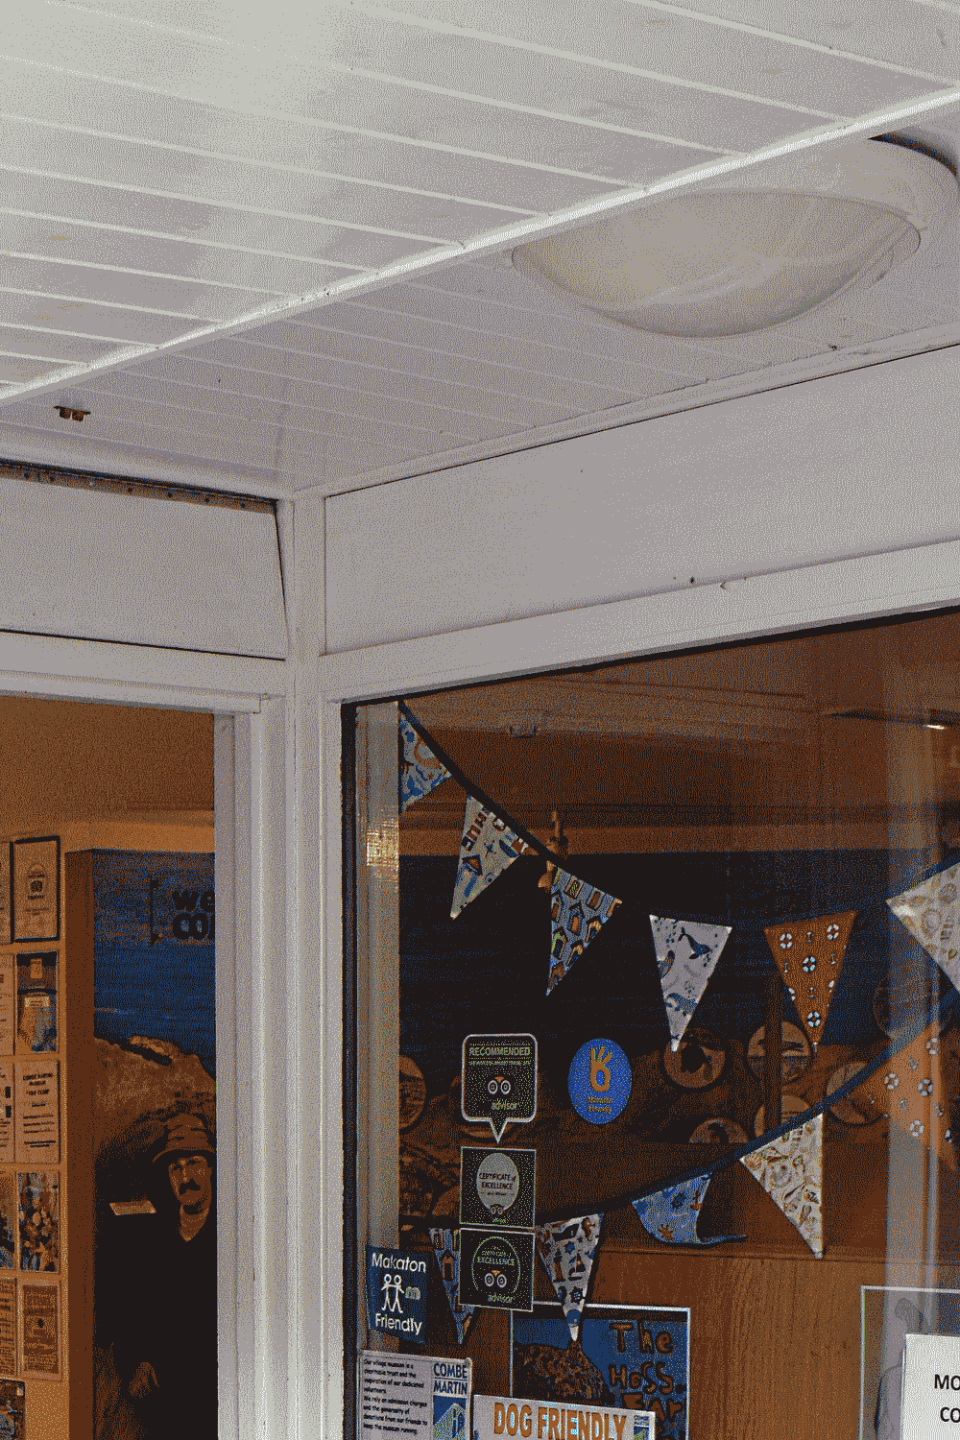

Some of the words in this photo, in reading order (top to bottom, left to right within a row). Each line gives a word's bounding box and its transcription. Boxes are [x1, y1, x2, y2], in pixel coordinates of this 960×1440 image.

[469, 1047, 530, 1056] RECOMMENDED
[479, 1173, 510, 1181] CERTIFICATE
[481, 1182, 513, 1190] EXCELLENCE
[371, 1253, 426, 1273] Makaton
[477, 1256, 515, 1266] EXCELLENCE
[375, 1314, 422, 1335] Friendly
[609, 1320, 674, 1354] The
[434, 1362, 467, 1378] COMBE
[434, 1380, 467, 1394] MARTIN
[493, 1402, 532, 1437] DOG
